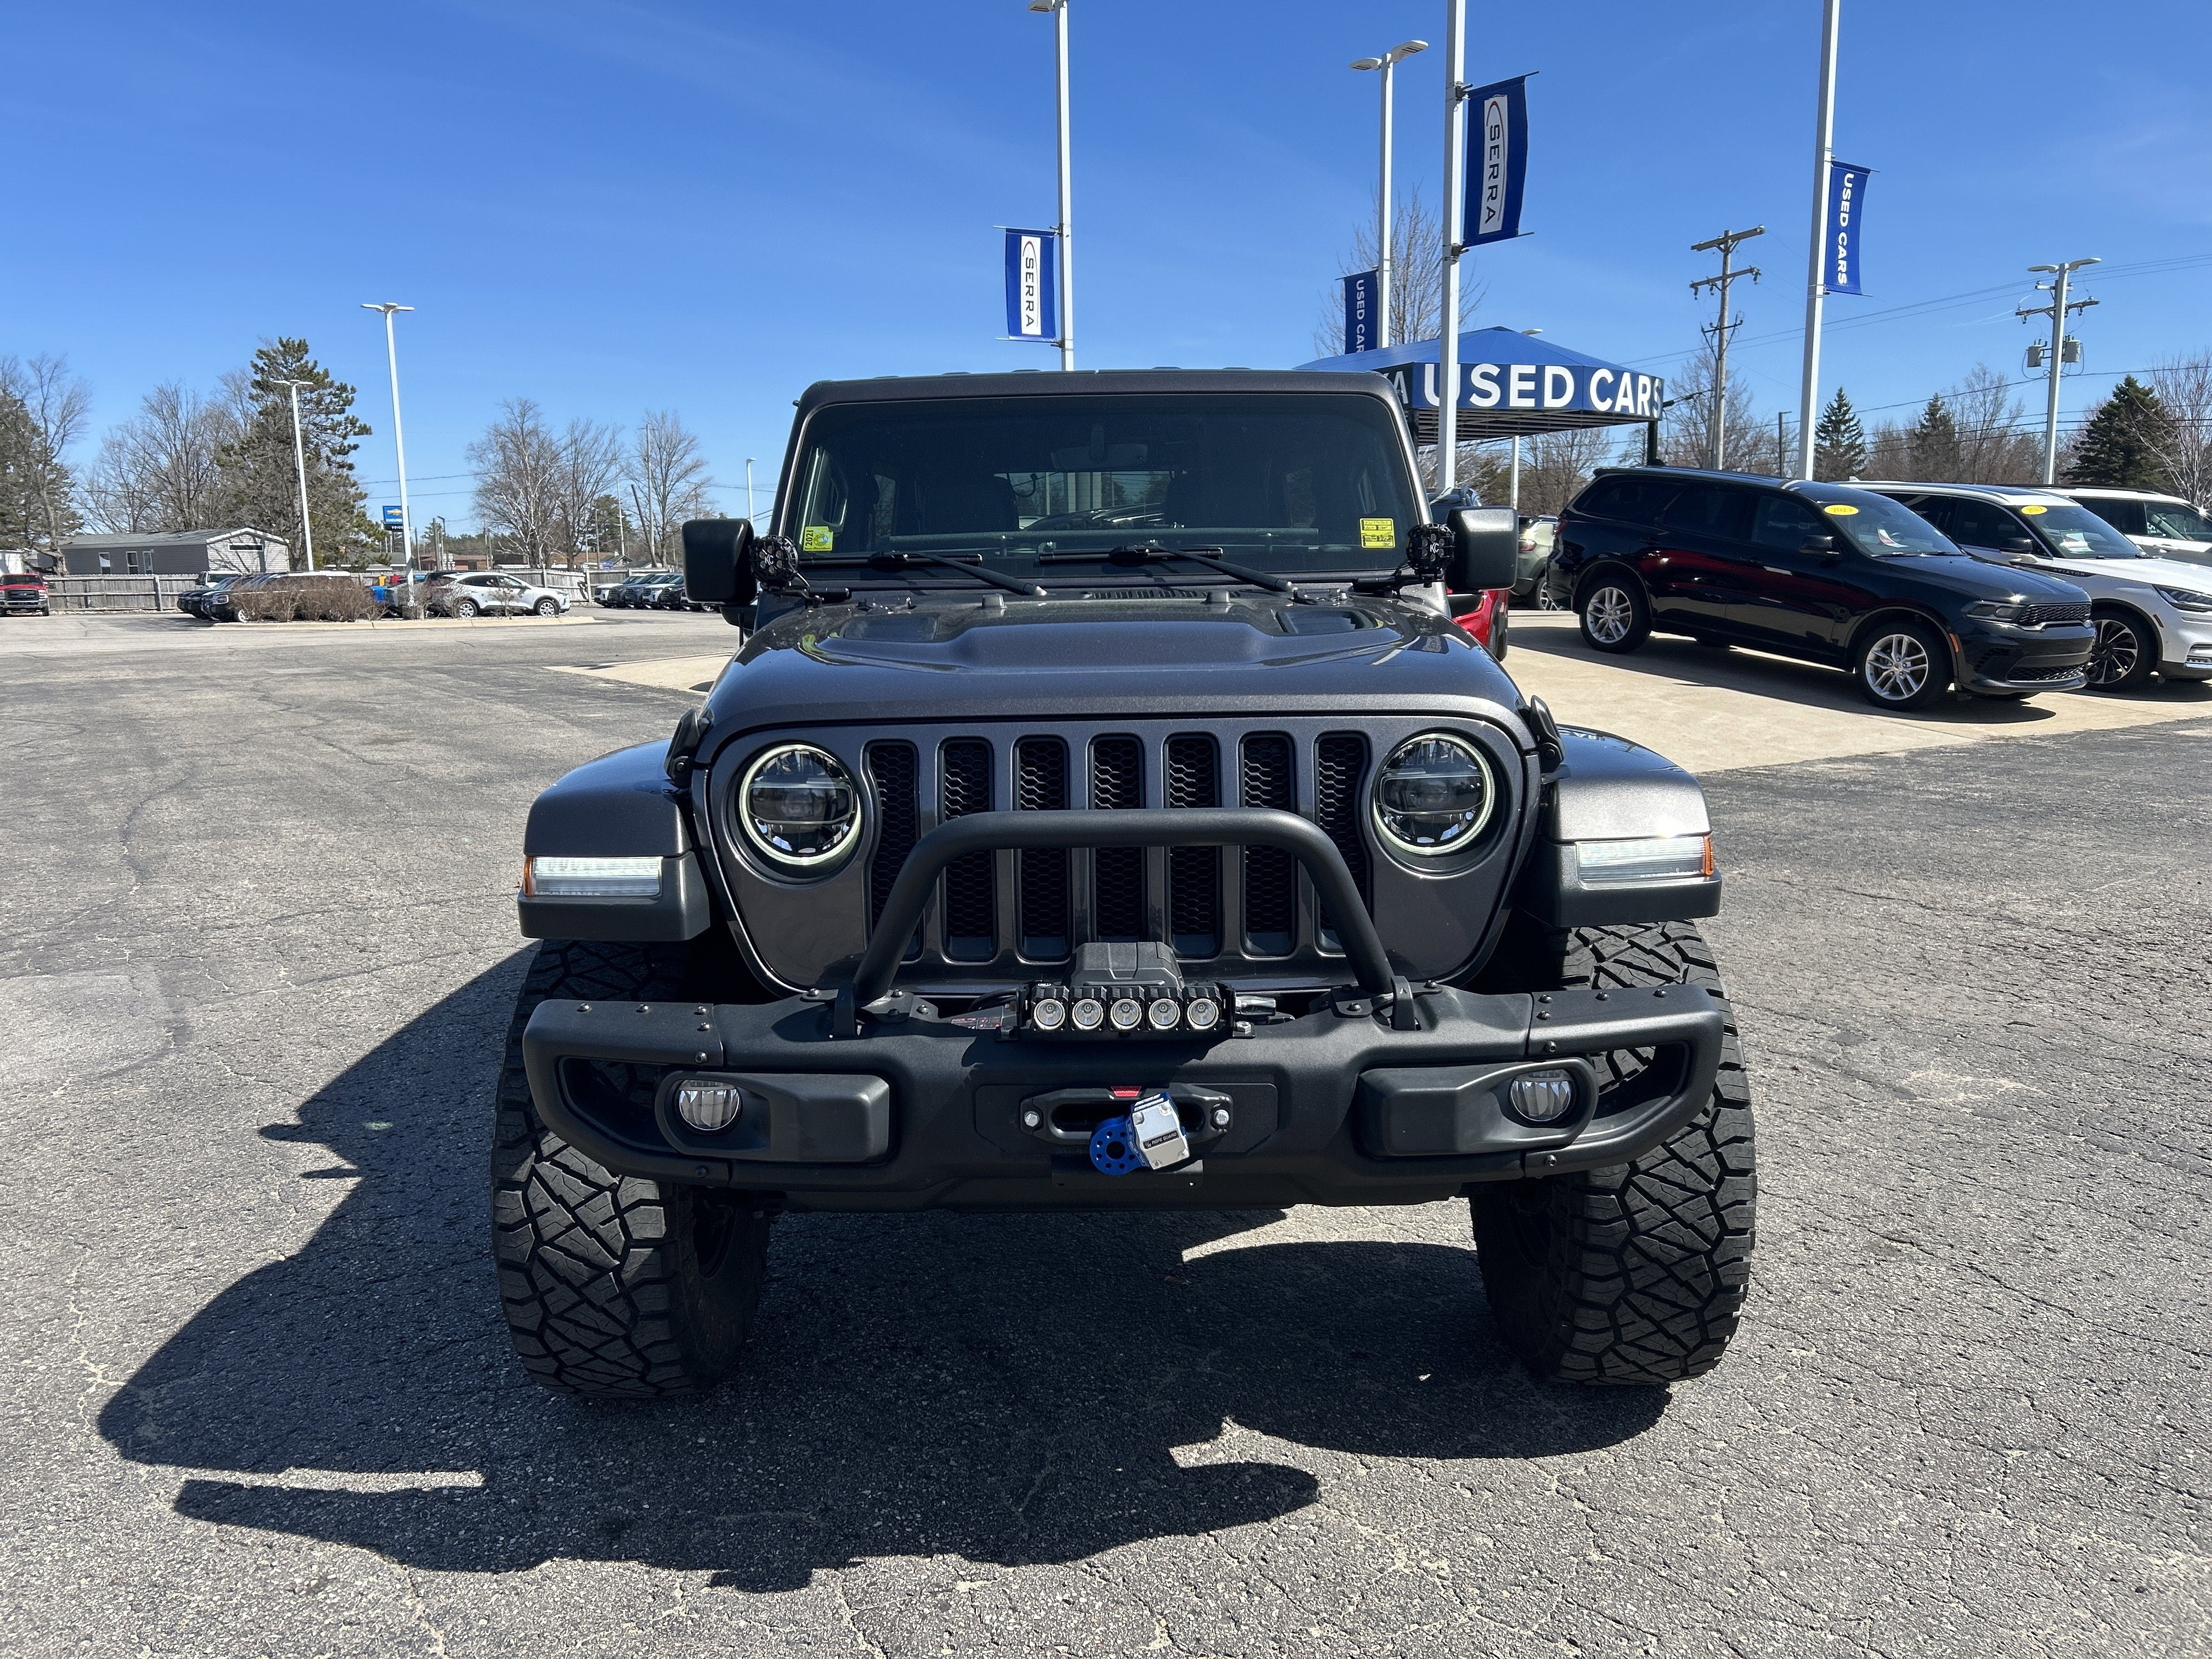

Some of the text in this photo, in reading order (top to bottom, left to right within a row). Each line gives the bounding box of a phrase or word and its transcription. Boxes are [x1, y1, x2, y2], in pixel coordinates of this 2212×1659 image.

[1485, 124, 1500, 224] SERRA
[1837, 173, 1854, 284] USED CARS
[1025, 257, 1034, 327] SERRA
[1356, 279, 1365, 354] USED CAR
[1424, 363, 1575, 408] USED
[1589, 368, 1662, 419] CARS
[764, 554, 774, 566] KC
[805, 530, 814, 546] 2021
[1430, 542, 1440, 554] KC
